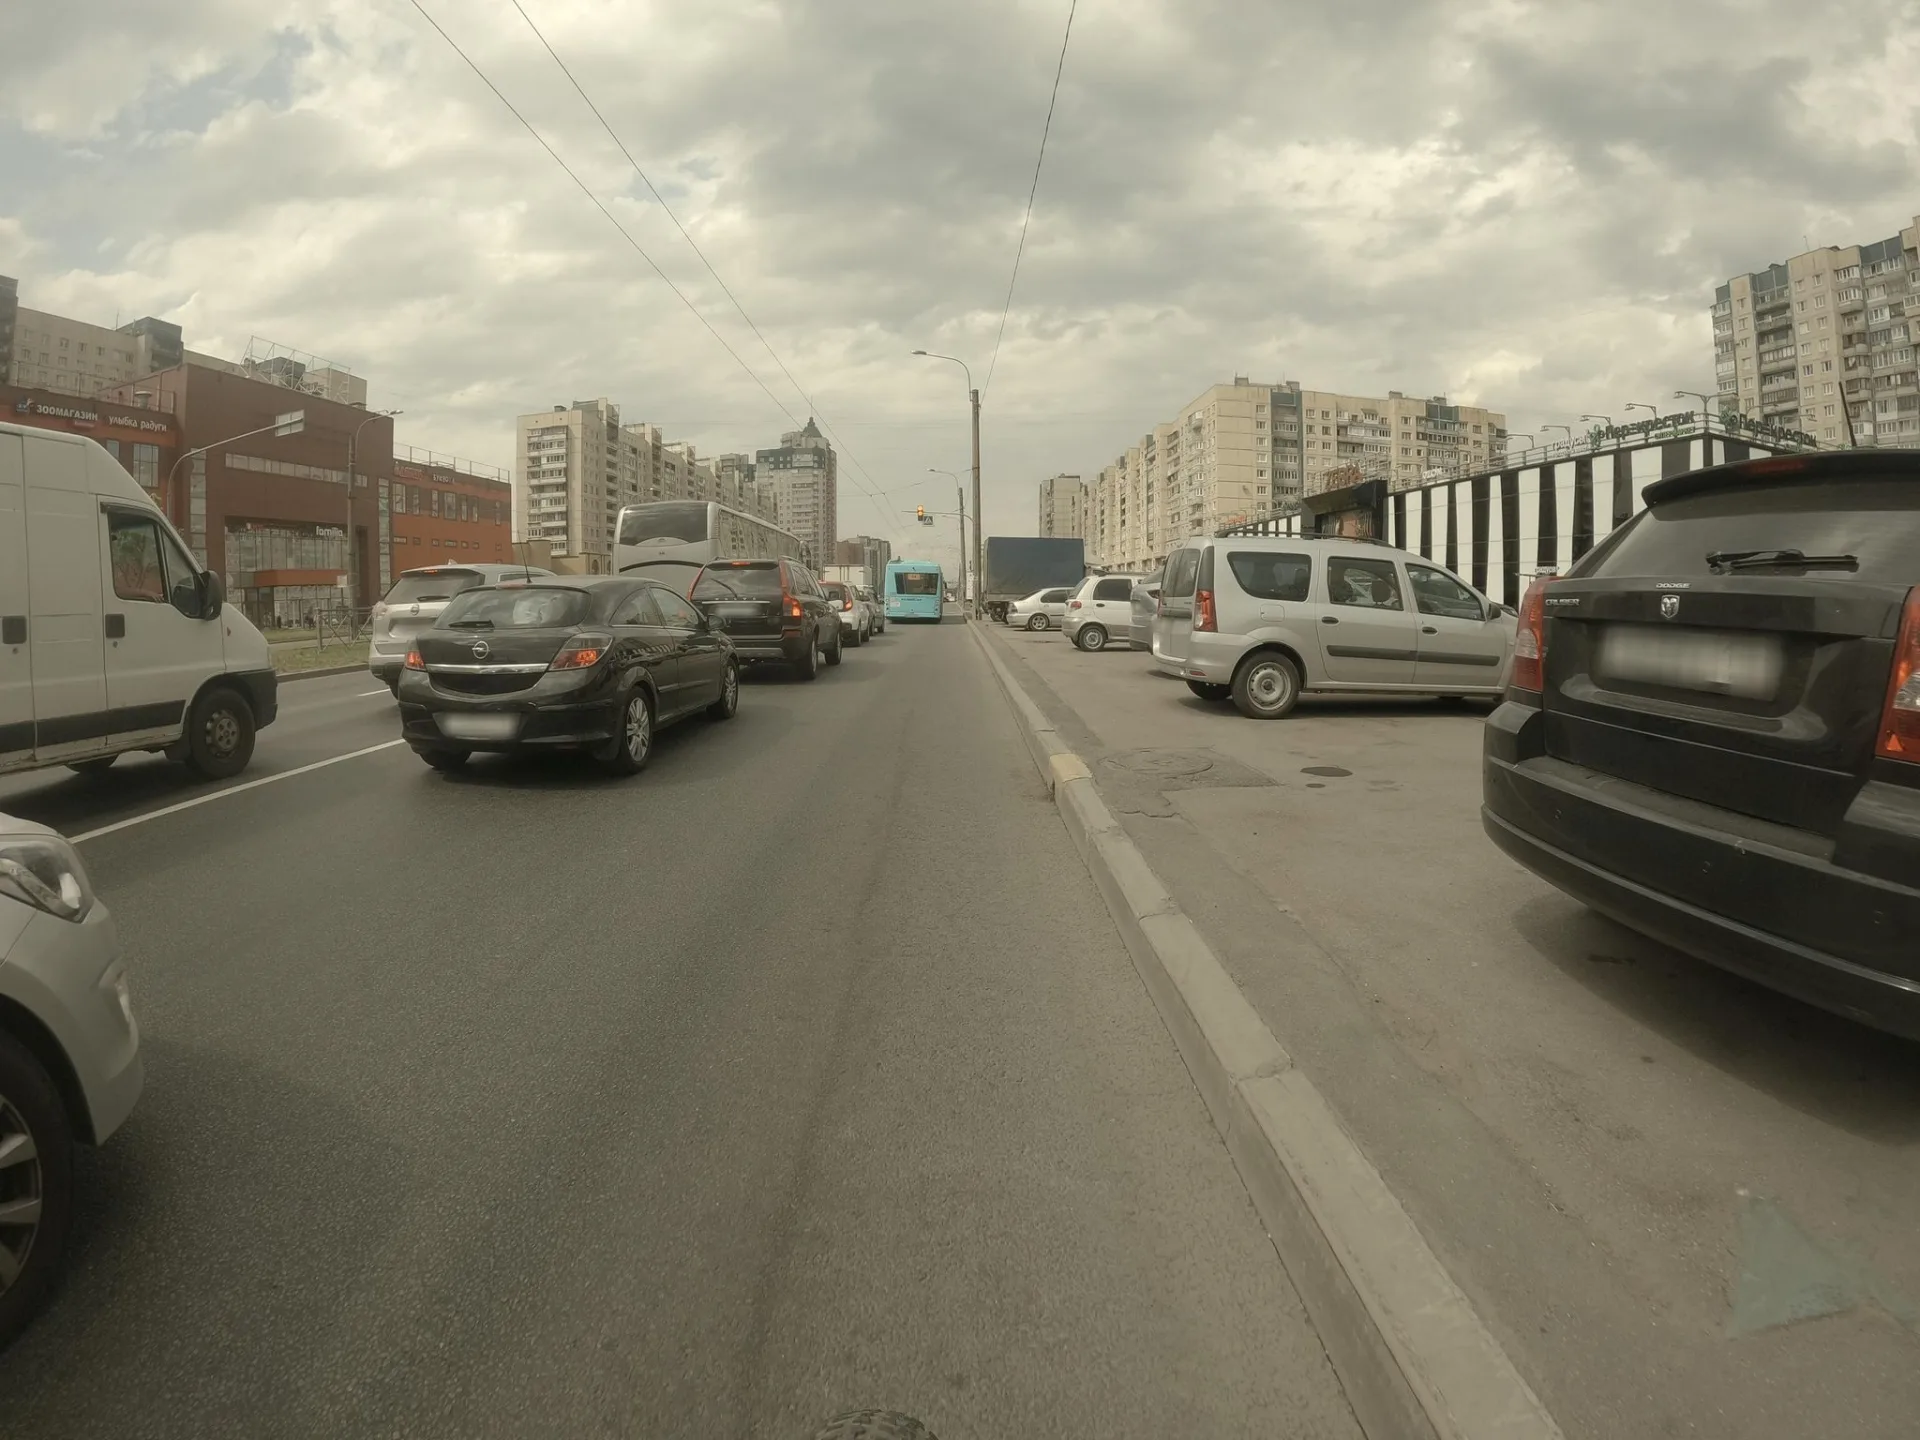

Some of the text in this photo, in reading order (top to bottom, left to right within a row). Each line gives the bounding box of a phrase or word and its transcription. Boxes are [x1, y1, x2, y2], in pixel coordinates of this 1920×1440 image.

[36, 404, 98, 421] ЗООМАГАЗИН
[108, 415, 138, 428] улыбка
[140, 420, 167, 432] радуги
[316, 525, 343, 537] familia
